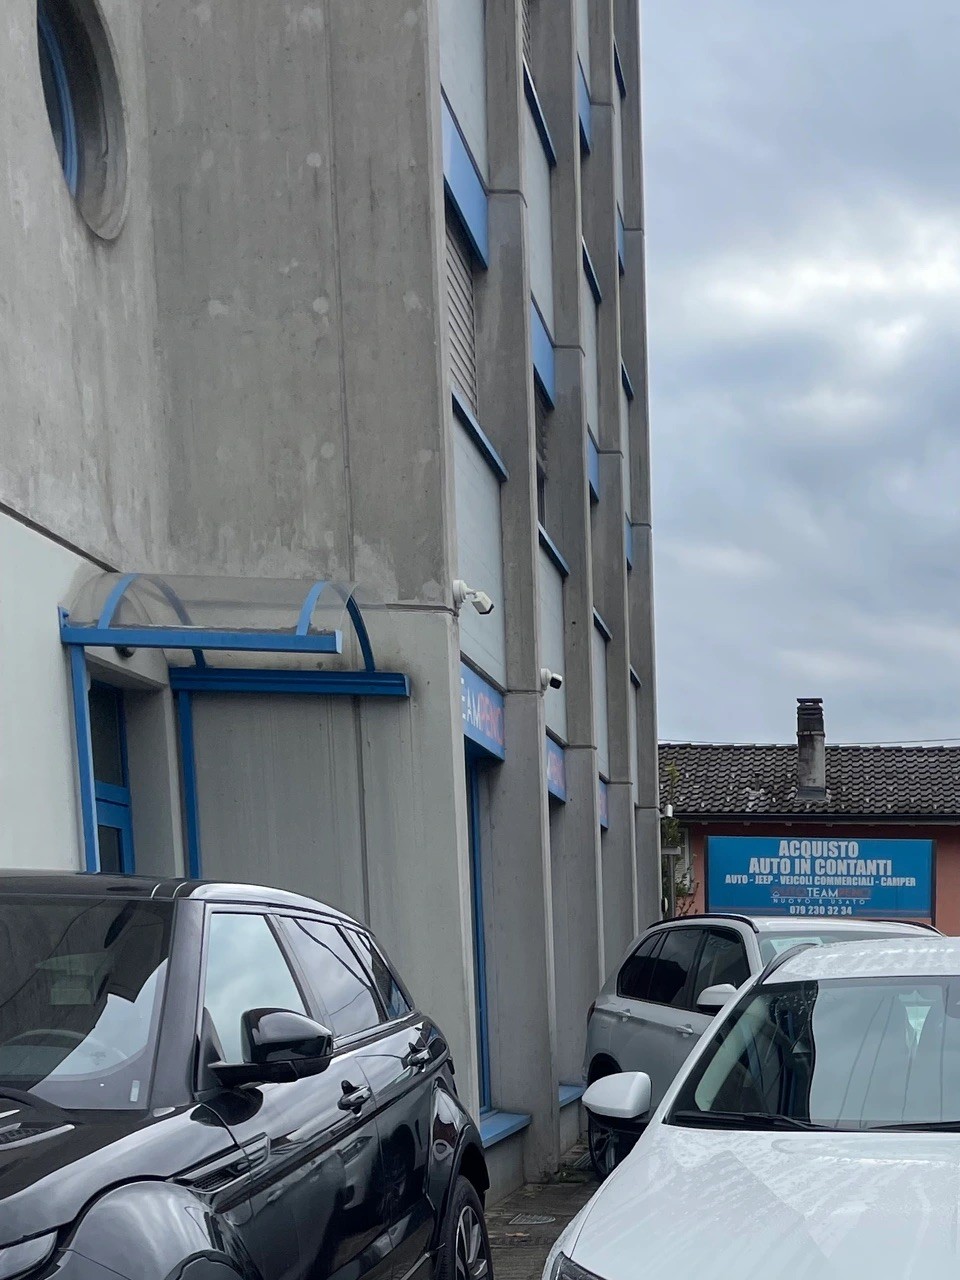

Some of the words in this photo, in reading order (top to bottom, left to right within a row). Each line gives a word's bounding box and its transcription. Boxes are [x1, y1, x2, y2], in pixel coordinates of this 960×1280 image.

[778, 840, 859, 858] ACQUISTO
[748, 858, 791, 875] AUTO
[794, 858, 811, 875] IN
[814, 859, 892, 876] CONTANTI
[725, 874, 748, 884] AUTO
[754, 875, 774, 885] JEEP
[780, 875, 812, 885] VEICOLI
[814, 876, 874, 886] COMMERCIALI
[880, 877, 916, 887] CAMPER
[789, 905, 806, 915] 079
[807, 905, 825, 915] 230
[827, 906, 839, 915] 32
[841, 906, 852, 915] 34
